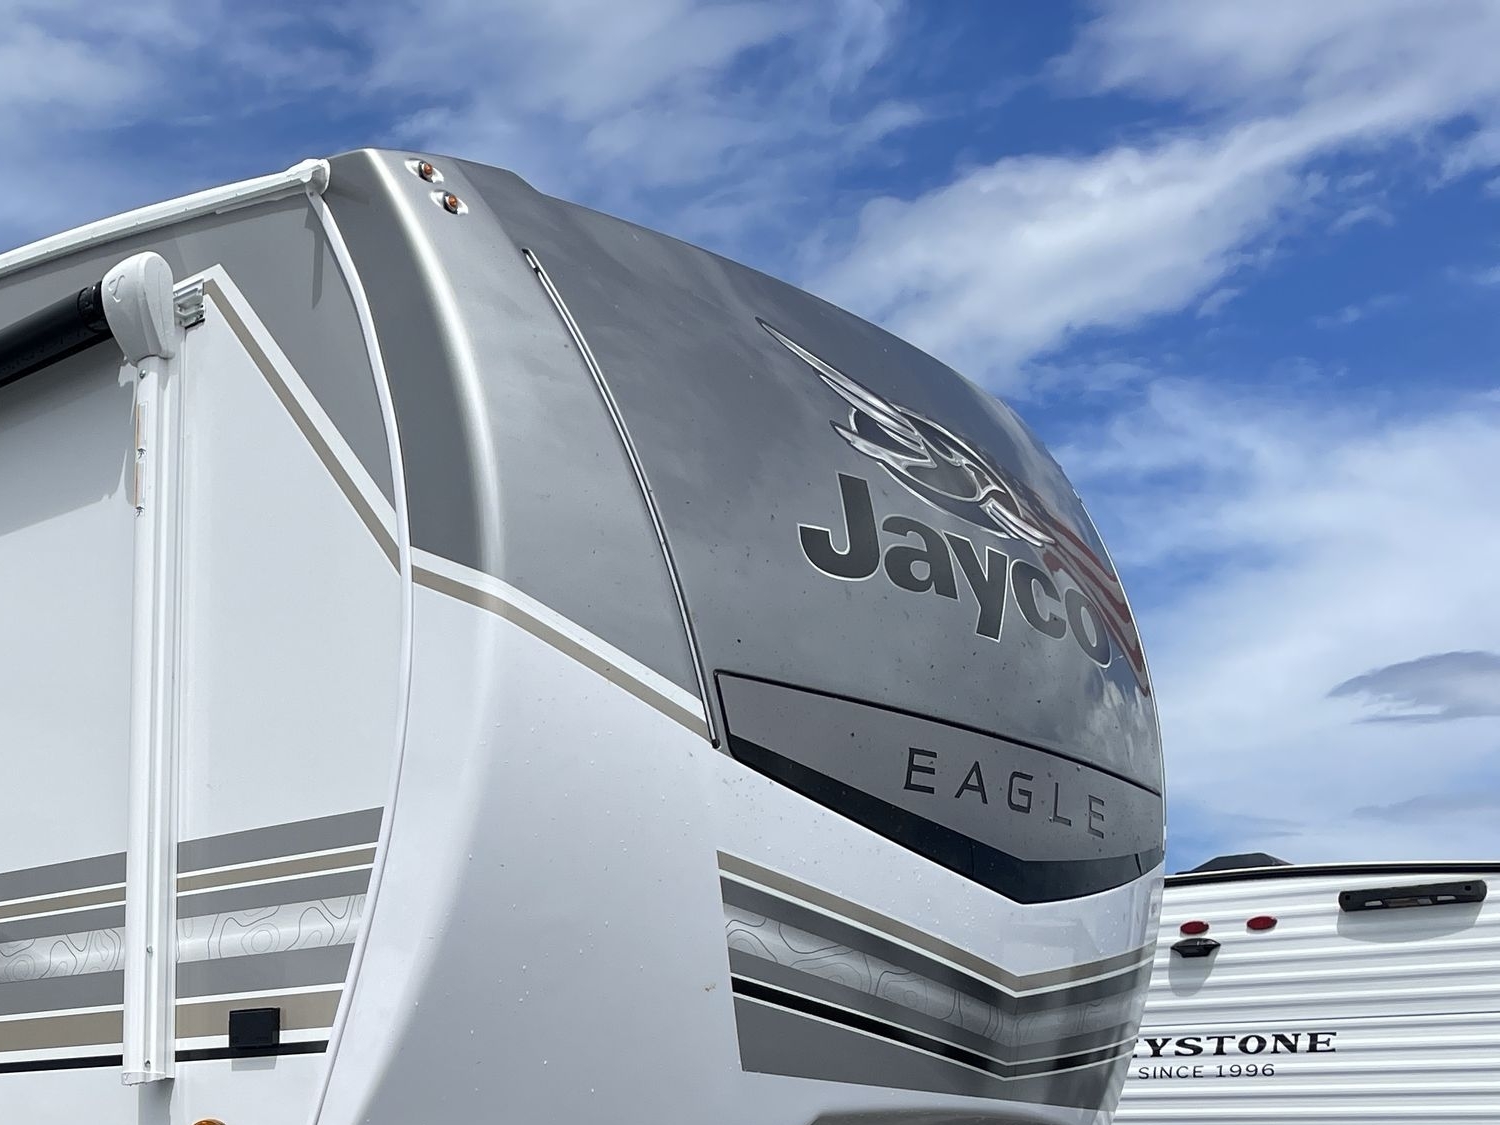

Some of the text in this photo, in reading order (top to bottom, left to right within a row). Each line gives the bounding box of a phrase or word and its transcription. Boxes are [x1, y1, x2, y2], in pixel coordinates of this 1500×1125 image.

[797, 472, 1112, 668] Jayco
[903, 746, 1105, 839] EAGLE
[1132, 1031, 1337, 1058] YSTONE
[1138, 1063, 1275, 1080] SINCE 1996
